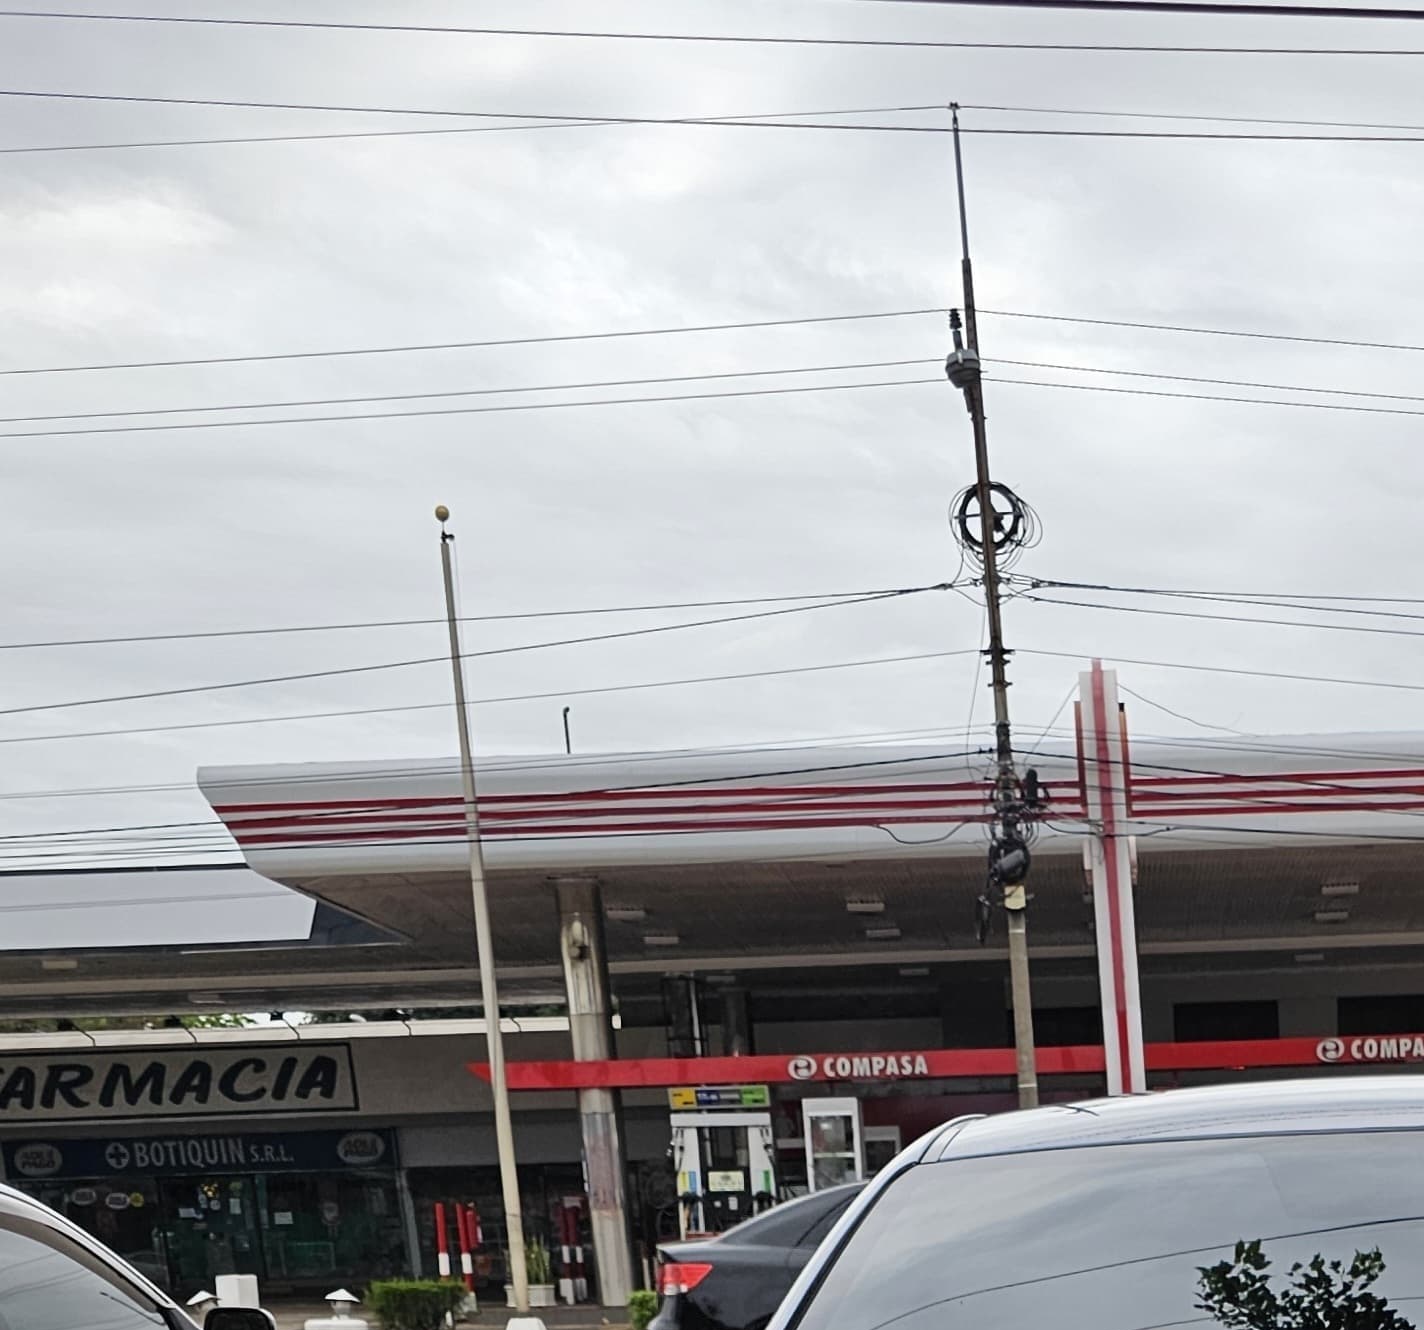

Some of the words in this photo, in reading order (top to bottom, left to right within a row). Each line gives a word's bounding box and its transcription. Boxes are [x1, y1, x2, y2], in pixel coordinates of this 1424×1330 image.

[823, 1055, 928, 1077] COMPASA
[0, 1055, 338, 1110] ARMACIA
[133, 1137, 245, 1168] BOTIQUIN
